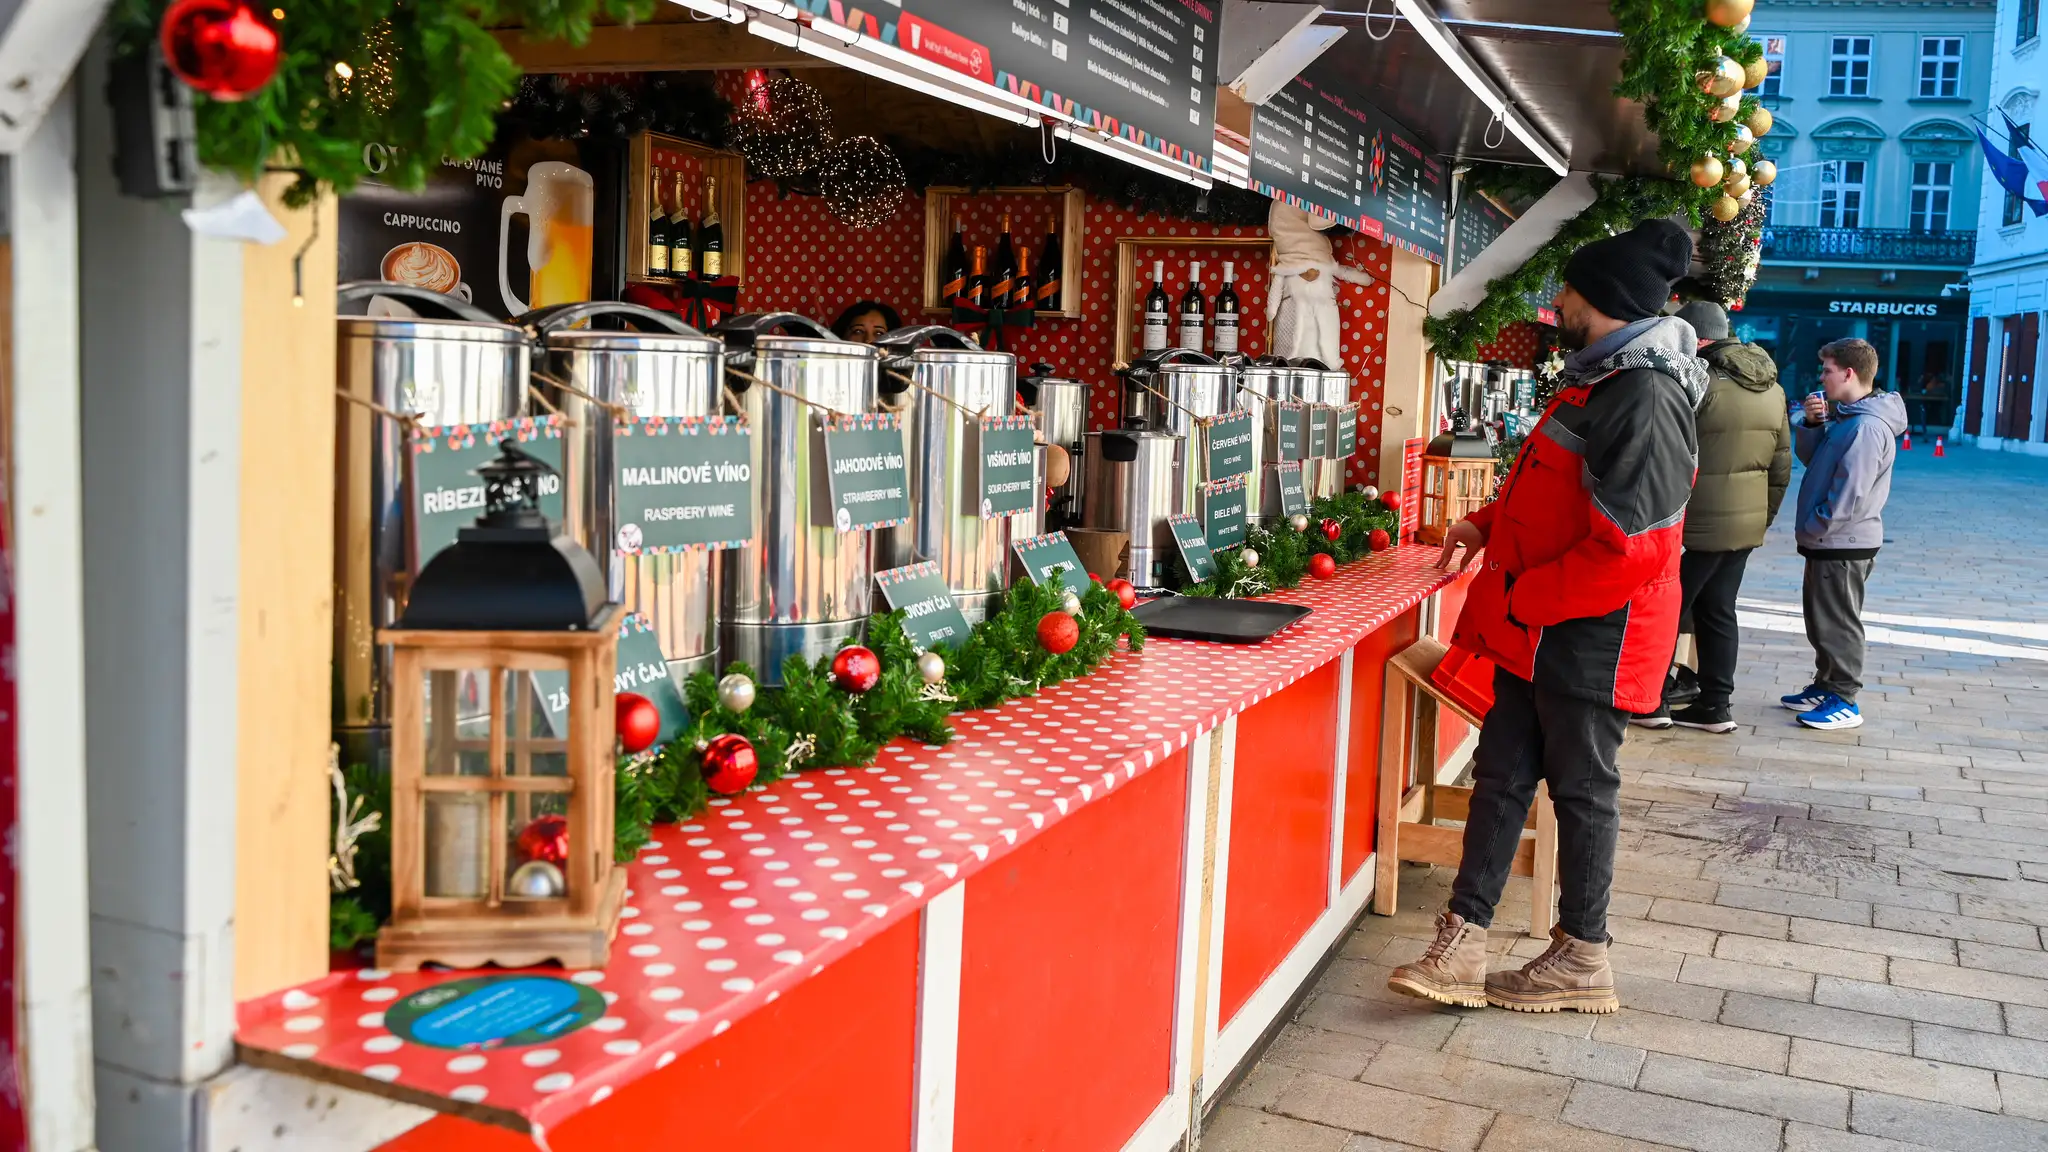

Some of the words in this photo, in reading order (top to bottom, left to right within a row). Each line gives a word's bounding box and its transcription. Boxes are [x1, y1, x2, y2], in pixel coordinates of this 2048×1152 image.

[476, 174, 503, 189] PIVO
[383, 212, 461, 234] CAPPUCCINO
[1828, 300, 1938, 316] STARBUCKS
[1212, 434, 1239, 451] ČERVENÉ
[1238, 432, 1251, 444] VÍNO
[834, 452, 883, 475] JAHODOVÉ
[883, 451, 904, 469] VÍNO
[987, 450, 1017, 468] VIŠŇOVÉ
[1017, 450, 1032, 465] VÍNO
[1223, 457, 1232, 465] RED
[1232, 455, 1242, 463] WINE
[622, 460, 712, 486] MALINOVÉ
[714, 460, 750, 482] VÍNO
[842, 488, 888, 505] STRAWBERRY
[887, 487, 902, 499] WINE
[987, 483, 1004, 495] SOUR
[1003, 481, 1020, 493] CHERRY
[1019, 480, 1031, 490] WINE
[644, 505, 706, 522] RASPBERY
[707, 503, 735, 518] WINE
[1214, 507, 1231, 520] BIELE
[1230, 504, 1242, 515] VÍNO
[1218, 526, 1230, 536] WHITE
[1230, 524, 1239, 533] WINE
[933, 595, 951, 611] ČAJ
[637, 661, 667, 684] ČAJ
